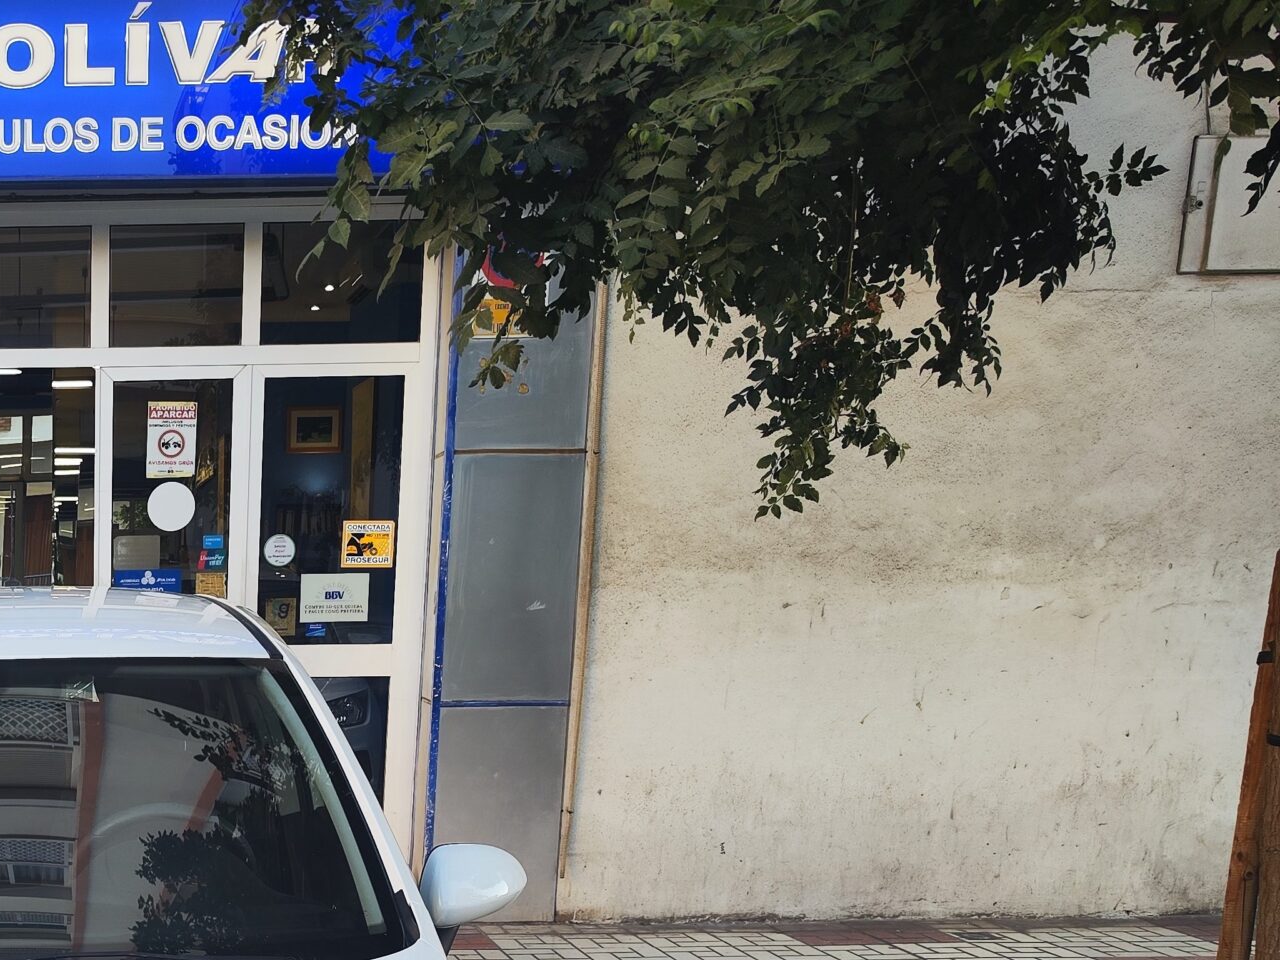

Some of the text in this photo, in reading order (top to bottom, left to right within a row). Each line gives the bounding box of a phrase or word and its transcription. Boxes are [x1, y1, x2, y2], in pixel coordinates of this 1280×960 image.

[111, 117, 165, 152] DE
[150, 410, 195, 419] APARCAR
[345, 556, 389, 564] PROSEGUR
